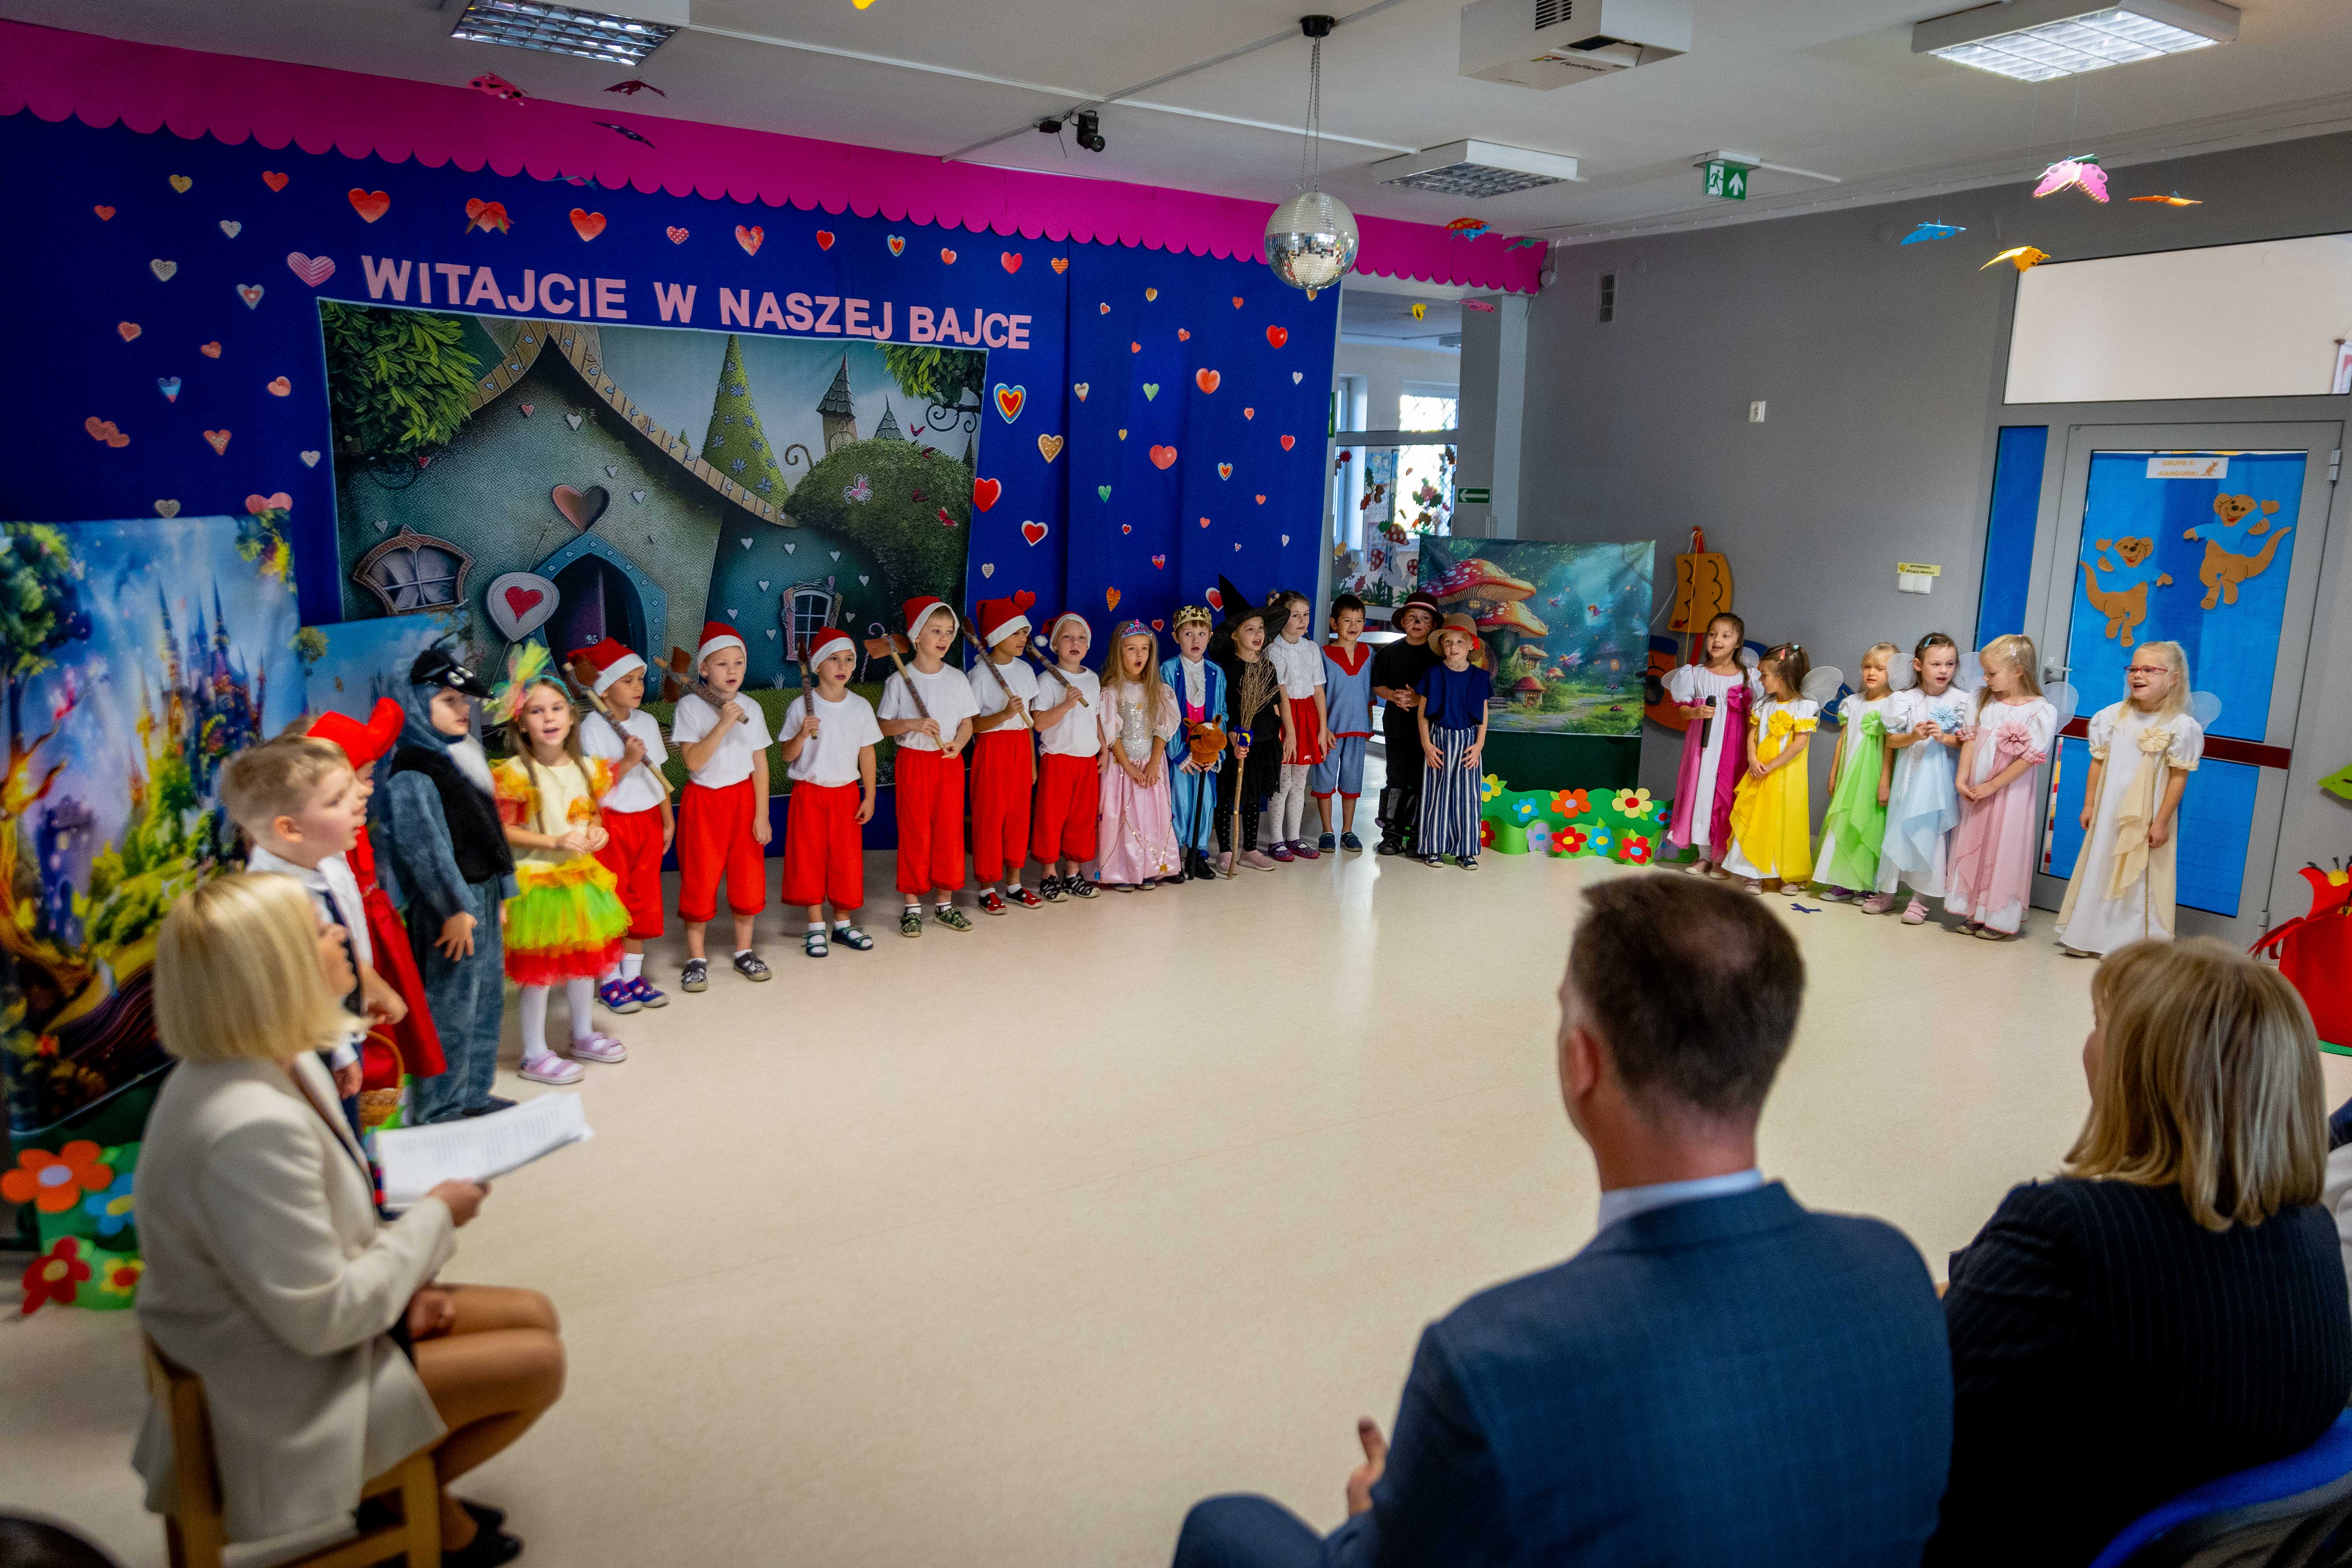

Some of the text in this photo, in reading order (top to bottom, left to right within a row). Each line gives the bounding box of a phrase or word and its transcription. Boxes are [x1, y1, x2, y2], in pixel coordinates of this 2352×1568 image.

[361, 255, 1032, 349] WITAJCIE W NASZEJ BAJCE
